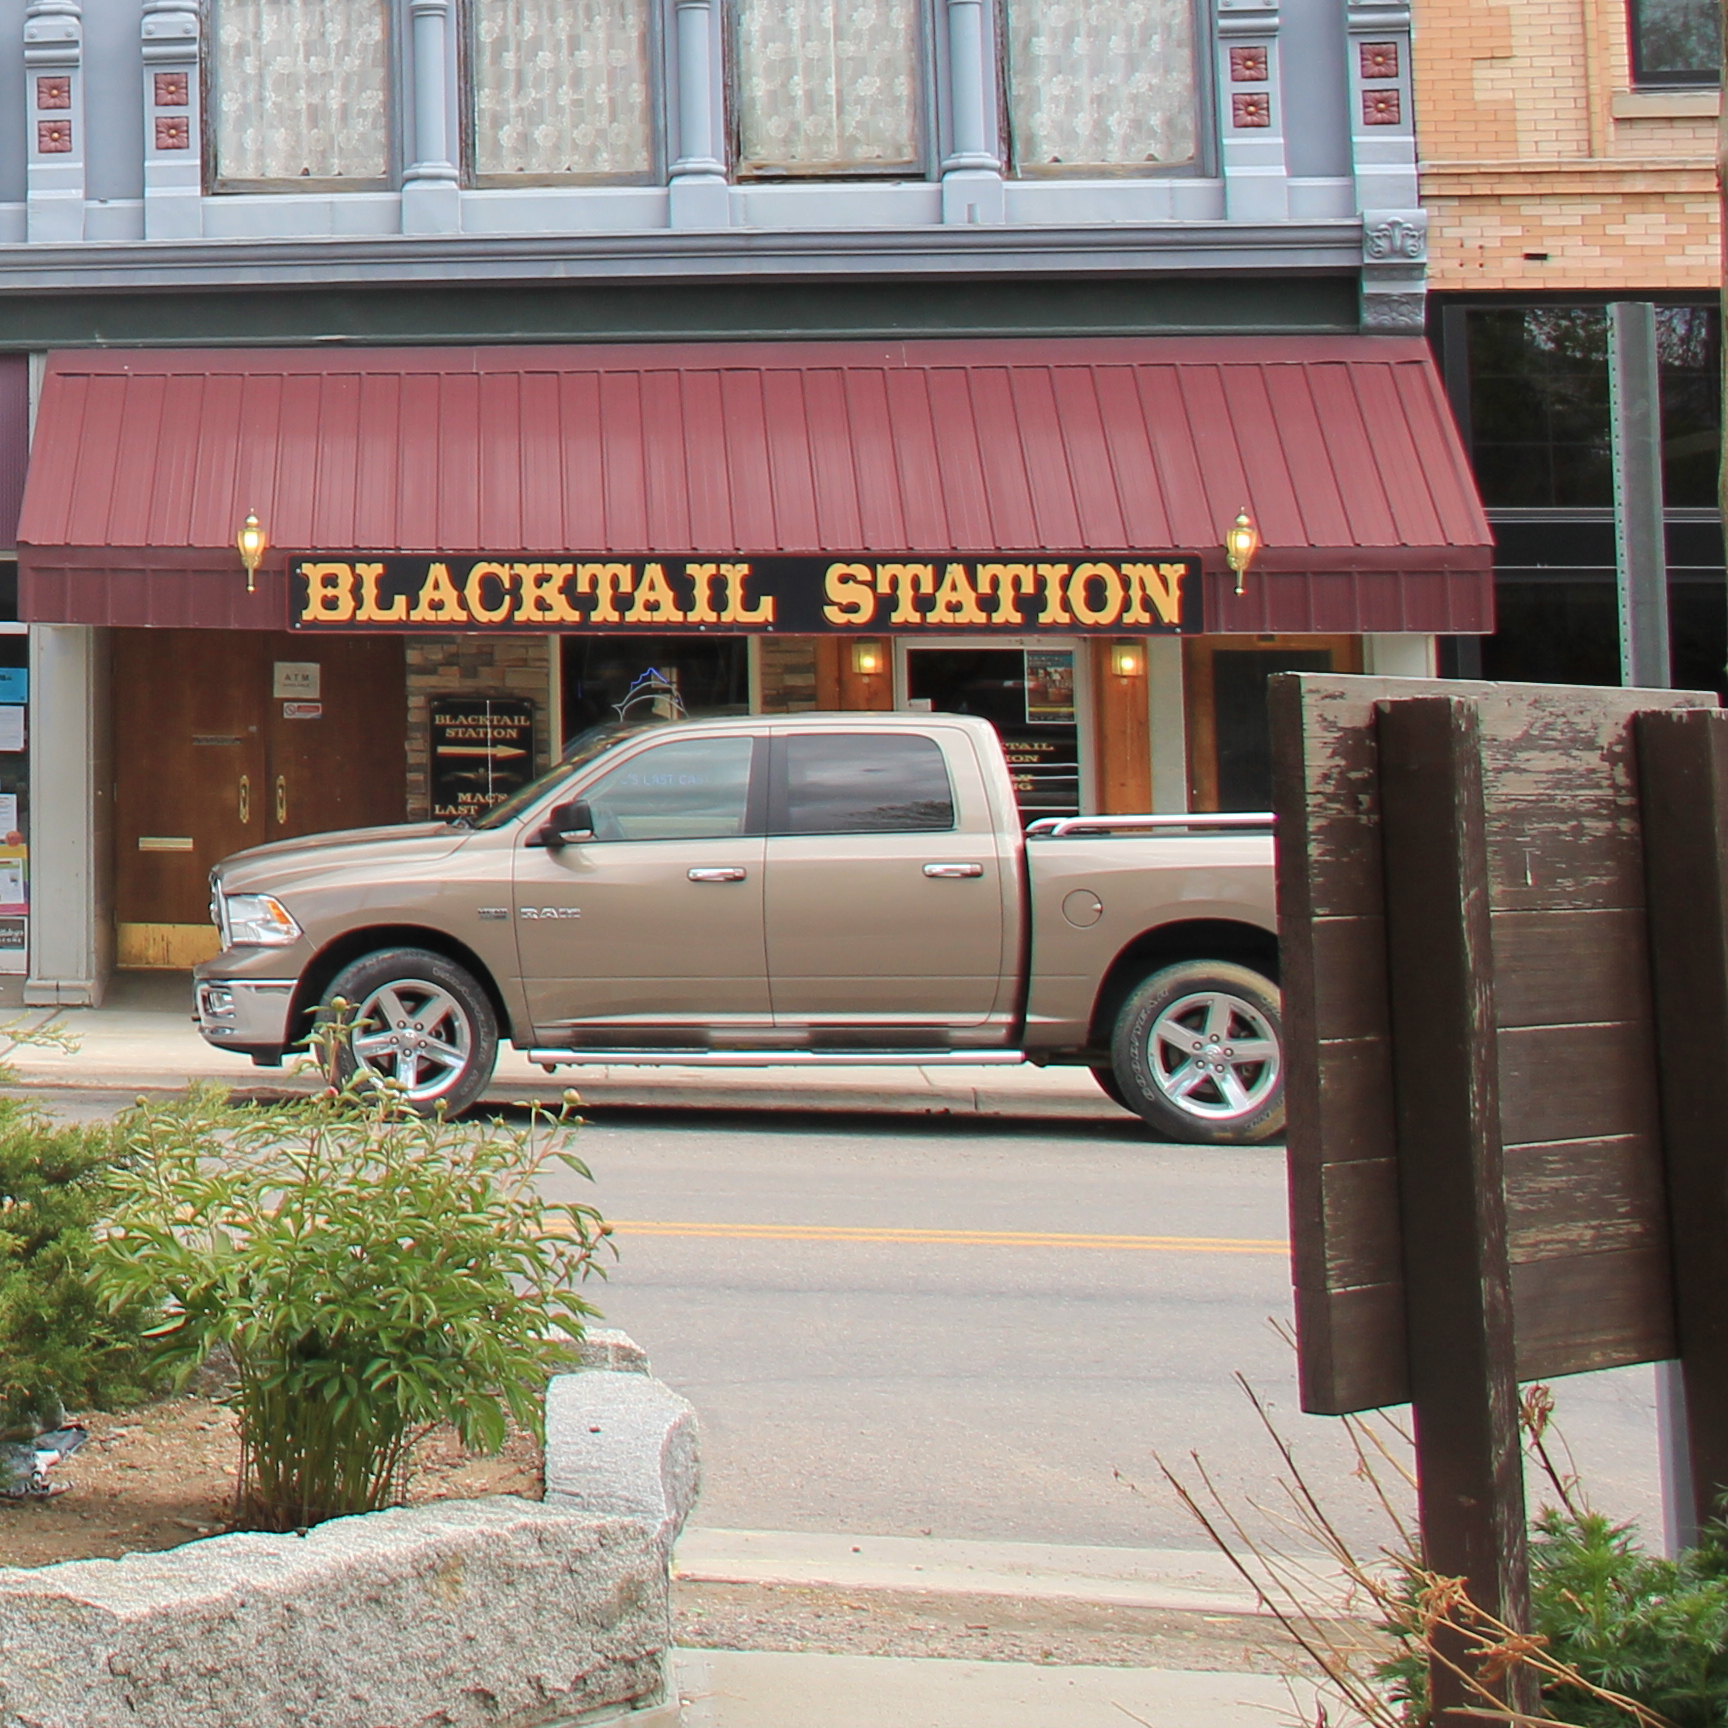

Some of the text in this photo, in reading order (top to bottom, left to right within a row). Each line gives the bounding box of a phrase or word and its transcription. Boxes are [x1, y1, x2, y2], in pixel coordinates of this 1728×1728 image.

[299, 561, 1187, 628] BLACKTAIL STATION
[284, 673, 310, 681] ATM
[434, 714, 531, 726] BLACKTAIL
[445, 727, 518, 739] STATION
[434, 804, 478, 816] LAST
[520, 907, 581, 919] RAM
